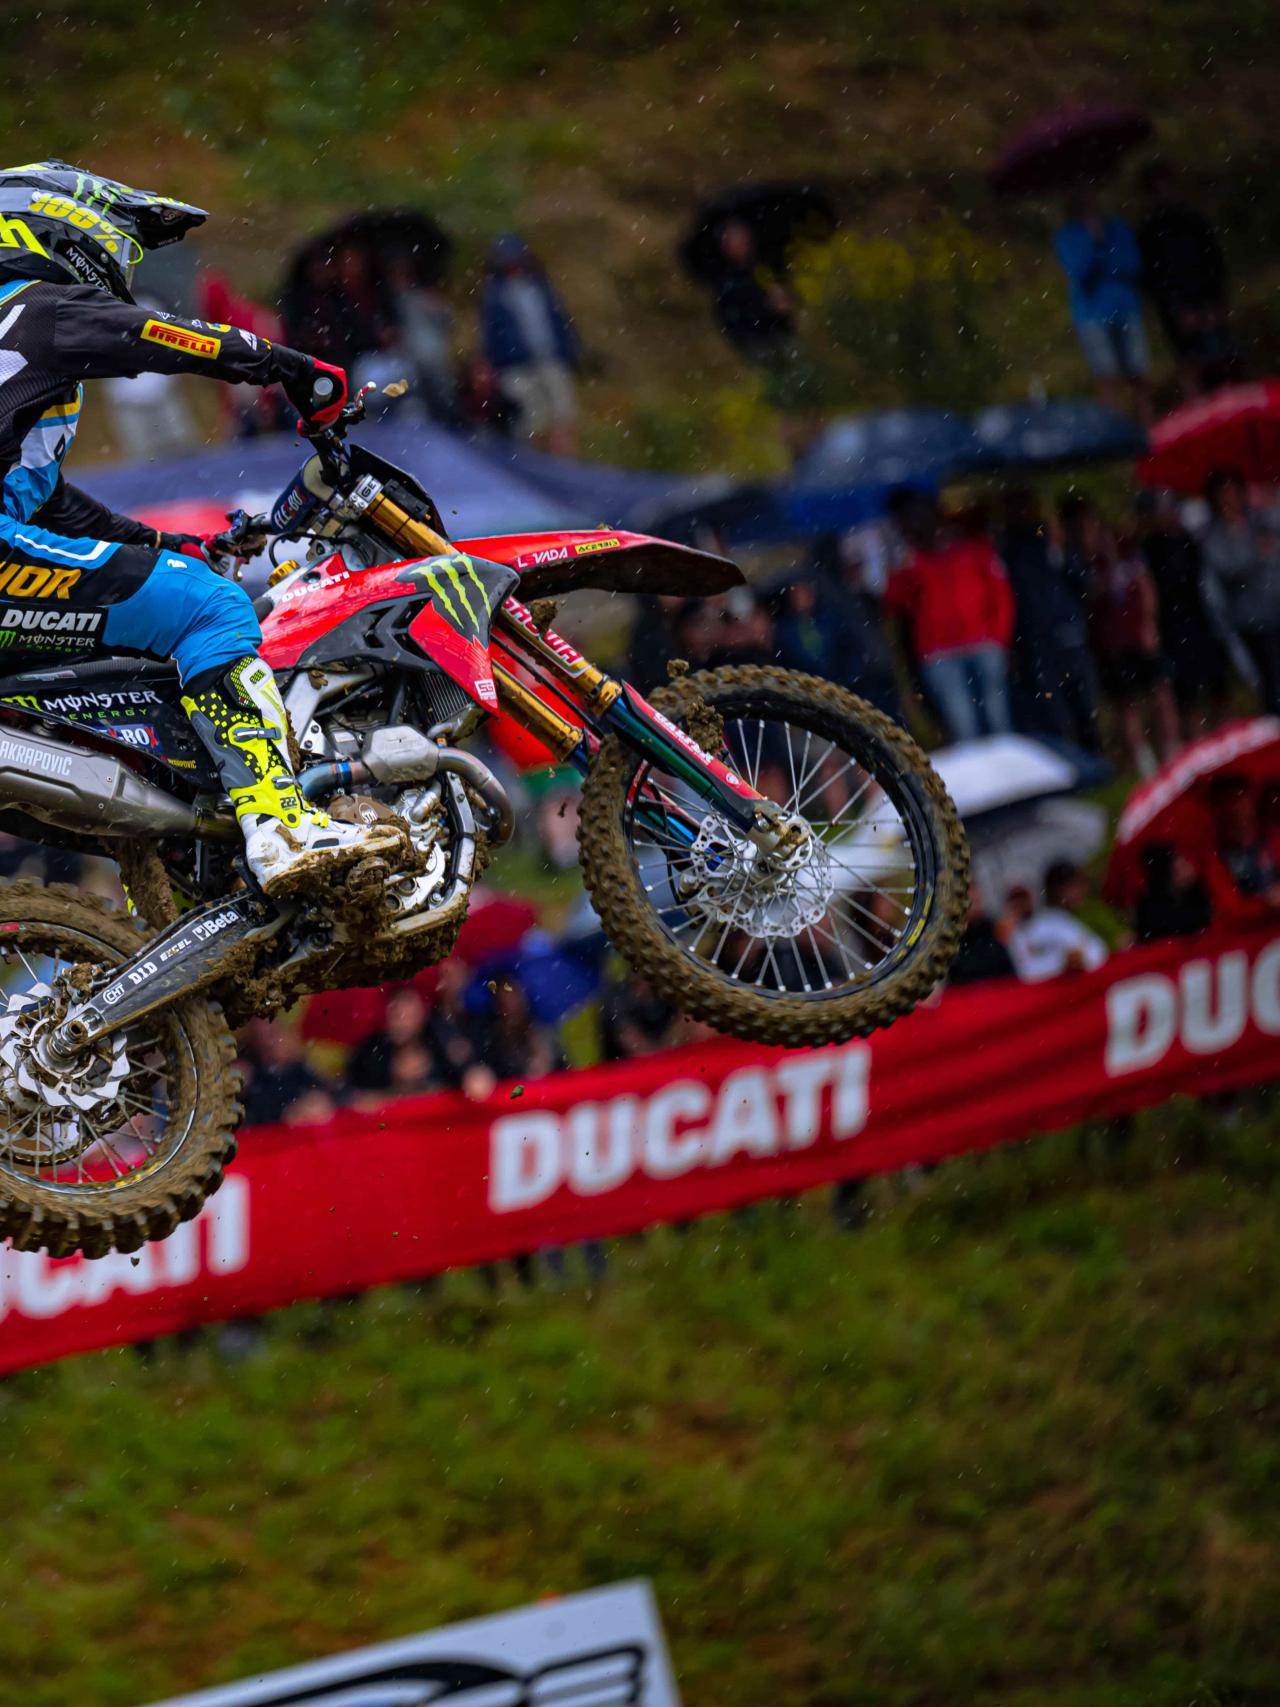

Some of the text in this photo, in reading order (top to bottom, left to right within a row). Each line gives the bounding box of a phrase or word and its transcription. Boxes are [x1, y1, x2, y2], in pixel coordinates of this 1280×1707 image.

[66, 247, 111, 293] MONST
[148, 325, 215, 354] PIRELLI
[578, 540, 618, 552] ACERBIS
[282, 571, 350, 603] DUCATI
[1, 609, 102, 631] DUCATI
[19, 634, 95, 648] MONSTER
[43, 690, 163, 712] MONSTER
[69, 708, 147, 720] ENERGY
[280, 796, 297, 809] 222
[203, 910, 239, 935] Beta
[159, 938, 192, 962] EXCEL
[489, 1045, 871, 1214] DUCATI
